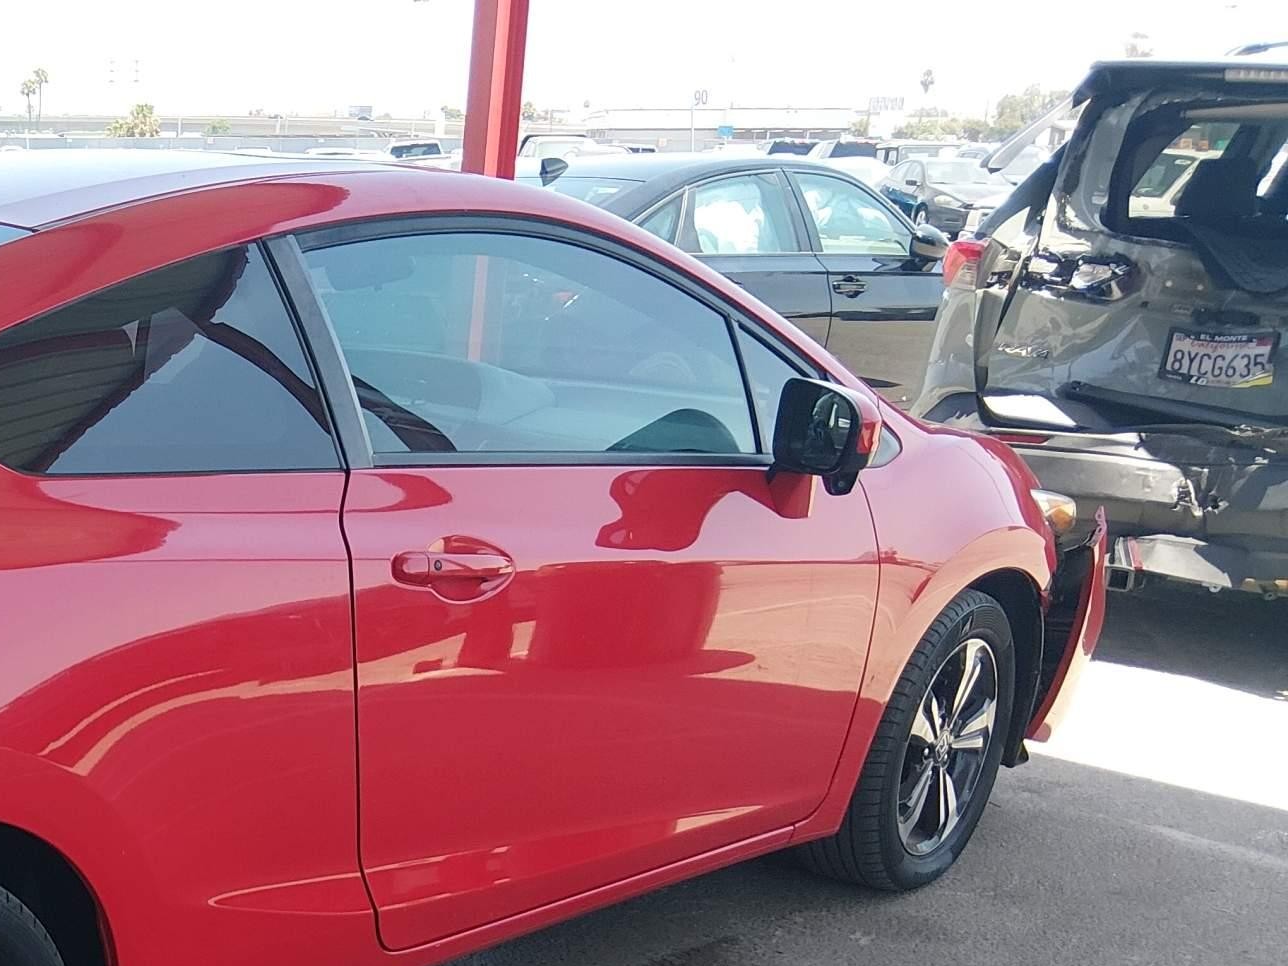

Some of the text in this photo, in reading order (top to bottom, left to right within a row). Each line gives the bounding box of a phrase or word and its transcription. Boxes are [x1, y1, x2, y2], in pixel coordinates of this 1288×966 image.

[694, 89, 708, 106] 90
[1200, 333, 1211, 341] EL
[1171, 349, 1265, 378] 8YCG635
